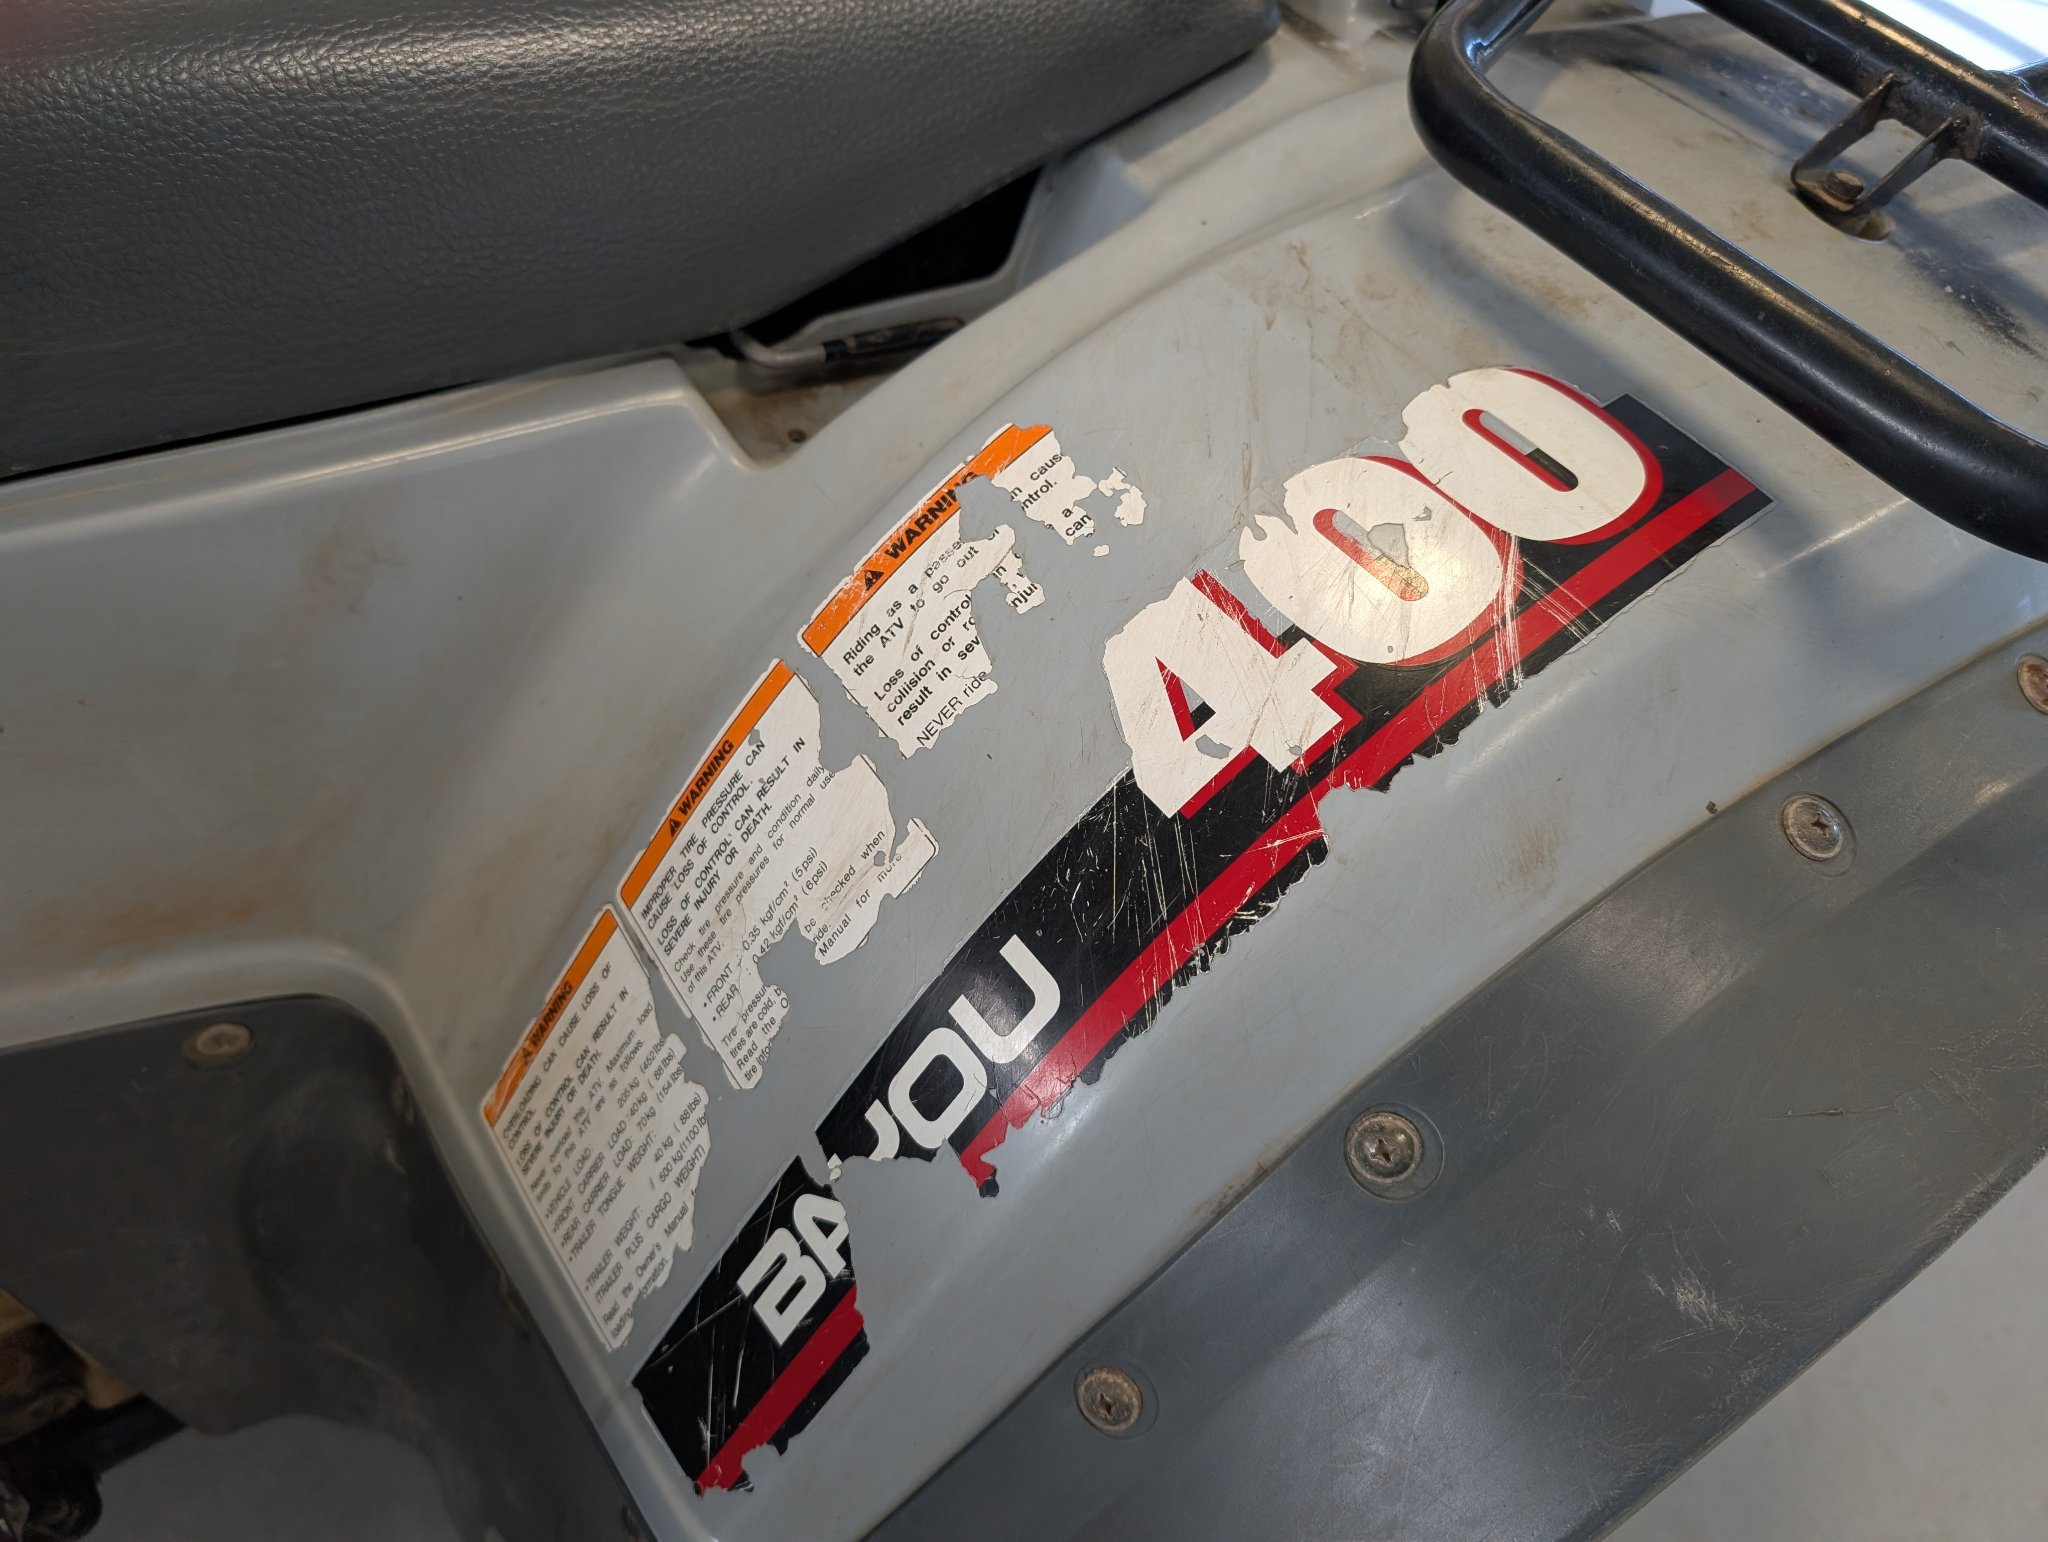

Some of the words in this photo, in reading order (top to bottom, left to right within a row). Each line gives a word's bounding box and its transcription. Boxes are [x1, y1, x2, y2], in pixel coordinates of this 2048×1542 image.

[842, 624, 881, 665] Riding
[886, 600, 902, 618] as
[908, 583, 919, 595] a
[924, 537, 966, 579] passe
[1029, 452, 1065, 481] caus
[853, 654, 875, 677] the
[879, 617, 904, 649] ATV
[909, 598, 926, 613] to
[932, 574, 950, 594] go
[956, 546, 979, 568] out
[873, 668, 905, 701] Loss
[910, 644, 924, 662] of
[930, 594, 974, 640] control
[1061, 508, 1074, 518] a
[941, 636, 956, 653] or
[1065, 512, 1093, 537] can
[1103, 366, 1662, 820] 400
[897, 686, 933, 726] result
[935, 667, 952, 682] in
[957, 635, 981, 661] sev
[916, 696, 963, 746] NEVER
[963, 672, 988, 698] ride
[641, 865, 677, 920] IMPROPER
[679, 832, 699, 858] TIRE
[701, 770, 743, 828] PRESSURE
[745, 740, 766, 767] CAN
[678, 740, 734, 816] WARNING
[647, 891, 673, 930] CAUSE
[673, 858, 695, 890] LOSS
[696, 836, 708, 856] OF
[710, 781, 753, 834] CONTROL.
[657, 915, 678, 946] LOSS
[680, 891, 691, 911] OF
[734, 804, 754, 831] CAN
[756, 755, 790, 801] RESULT
[792, 737, 806, 753] IN
[663, 913, 693, 957] SEVERE
[693, 870, 721, 911] INJURY
[724, 846, 739, 866] OR
[740, 802, 772, 844] DEATH.
[674, 942, 696, 973] Check
[698, 919, 711, 936] tire
[714, 871, 744, 916] pressure
[748, 843, 763, 866] and
[767, 793, 802, 839] condition
[806, 761, 825, 787] daily
[680, 963, 695, 983] Use
[697, 931, 717, 958] these
[719, 908, 732, 926] tire
[735, 856, 770, 906] pressures
[772, 833, 785, 851] for
[789, 793, 816, 829] normal
[819, 768, 836, 790] use
[687, 979, 696, 994] of
[694, 964, 708, 982] this
[707, 940, 725, 966] ATV.
[721, 1025, 738, 1047] Tire
[739, 985, 767, 1024] pressur
[860, 831, 886, 860] when
[729, 1037, 747, 1059] tires
[745, 1020, 758, 1039] are
[757, 996, 777, 1021] cold,
[812, 923, 832, 946] ride.
[736, 1040, 758, 1071] Read
[761, 1016, 777, 1036] the
[818, 913, 852, 957] Manual
[855, 888, 871, 909] for
[741, 924, 761, 951] 0.35
[752, 938, 773, 966] 042
[530, 981, 573, 1047] WARNING
[558, 1013, 580, 1047] CAUSE
[581, 982, 600, 1011] LOSS
[601, 962, 611, 980] OF
[575, 1046, 591, 1069] CAN
[592, 1003, 617, 1043] RESULT
[618, 986, 629, 1002] IN
[605, 1029, 636, 1073] Maximum
[636, 1001, 654, 1025] load
[744, 1064, 758, 1082] tire
[624, 1232, 644, 1260] PLUS
[646, 1191, 672, 1229] CARGO
[673, 1144, 706, 1188] WEIGHT)
[626, 1132, 654, 1173] WEIGHT:
[635, 1242, 662, 1278] Owner's
[663, 1201, 689, 1238] Manual
